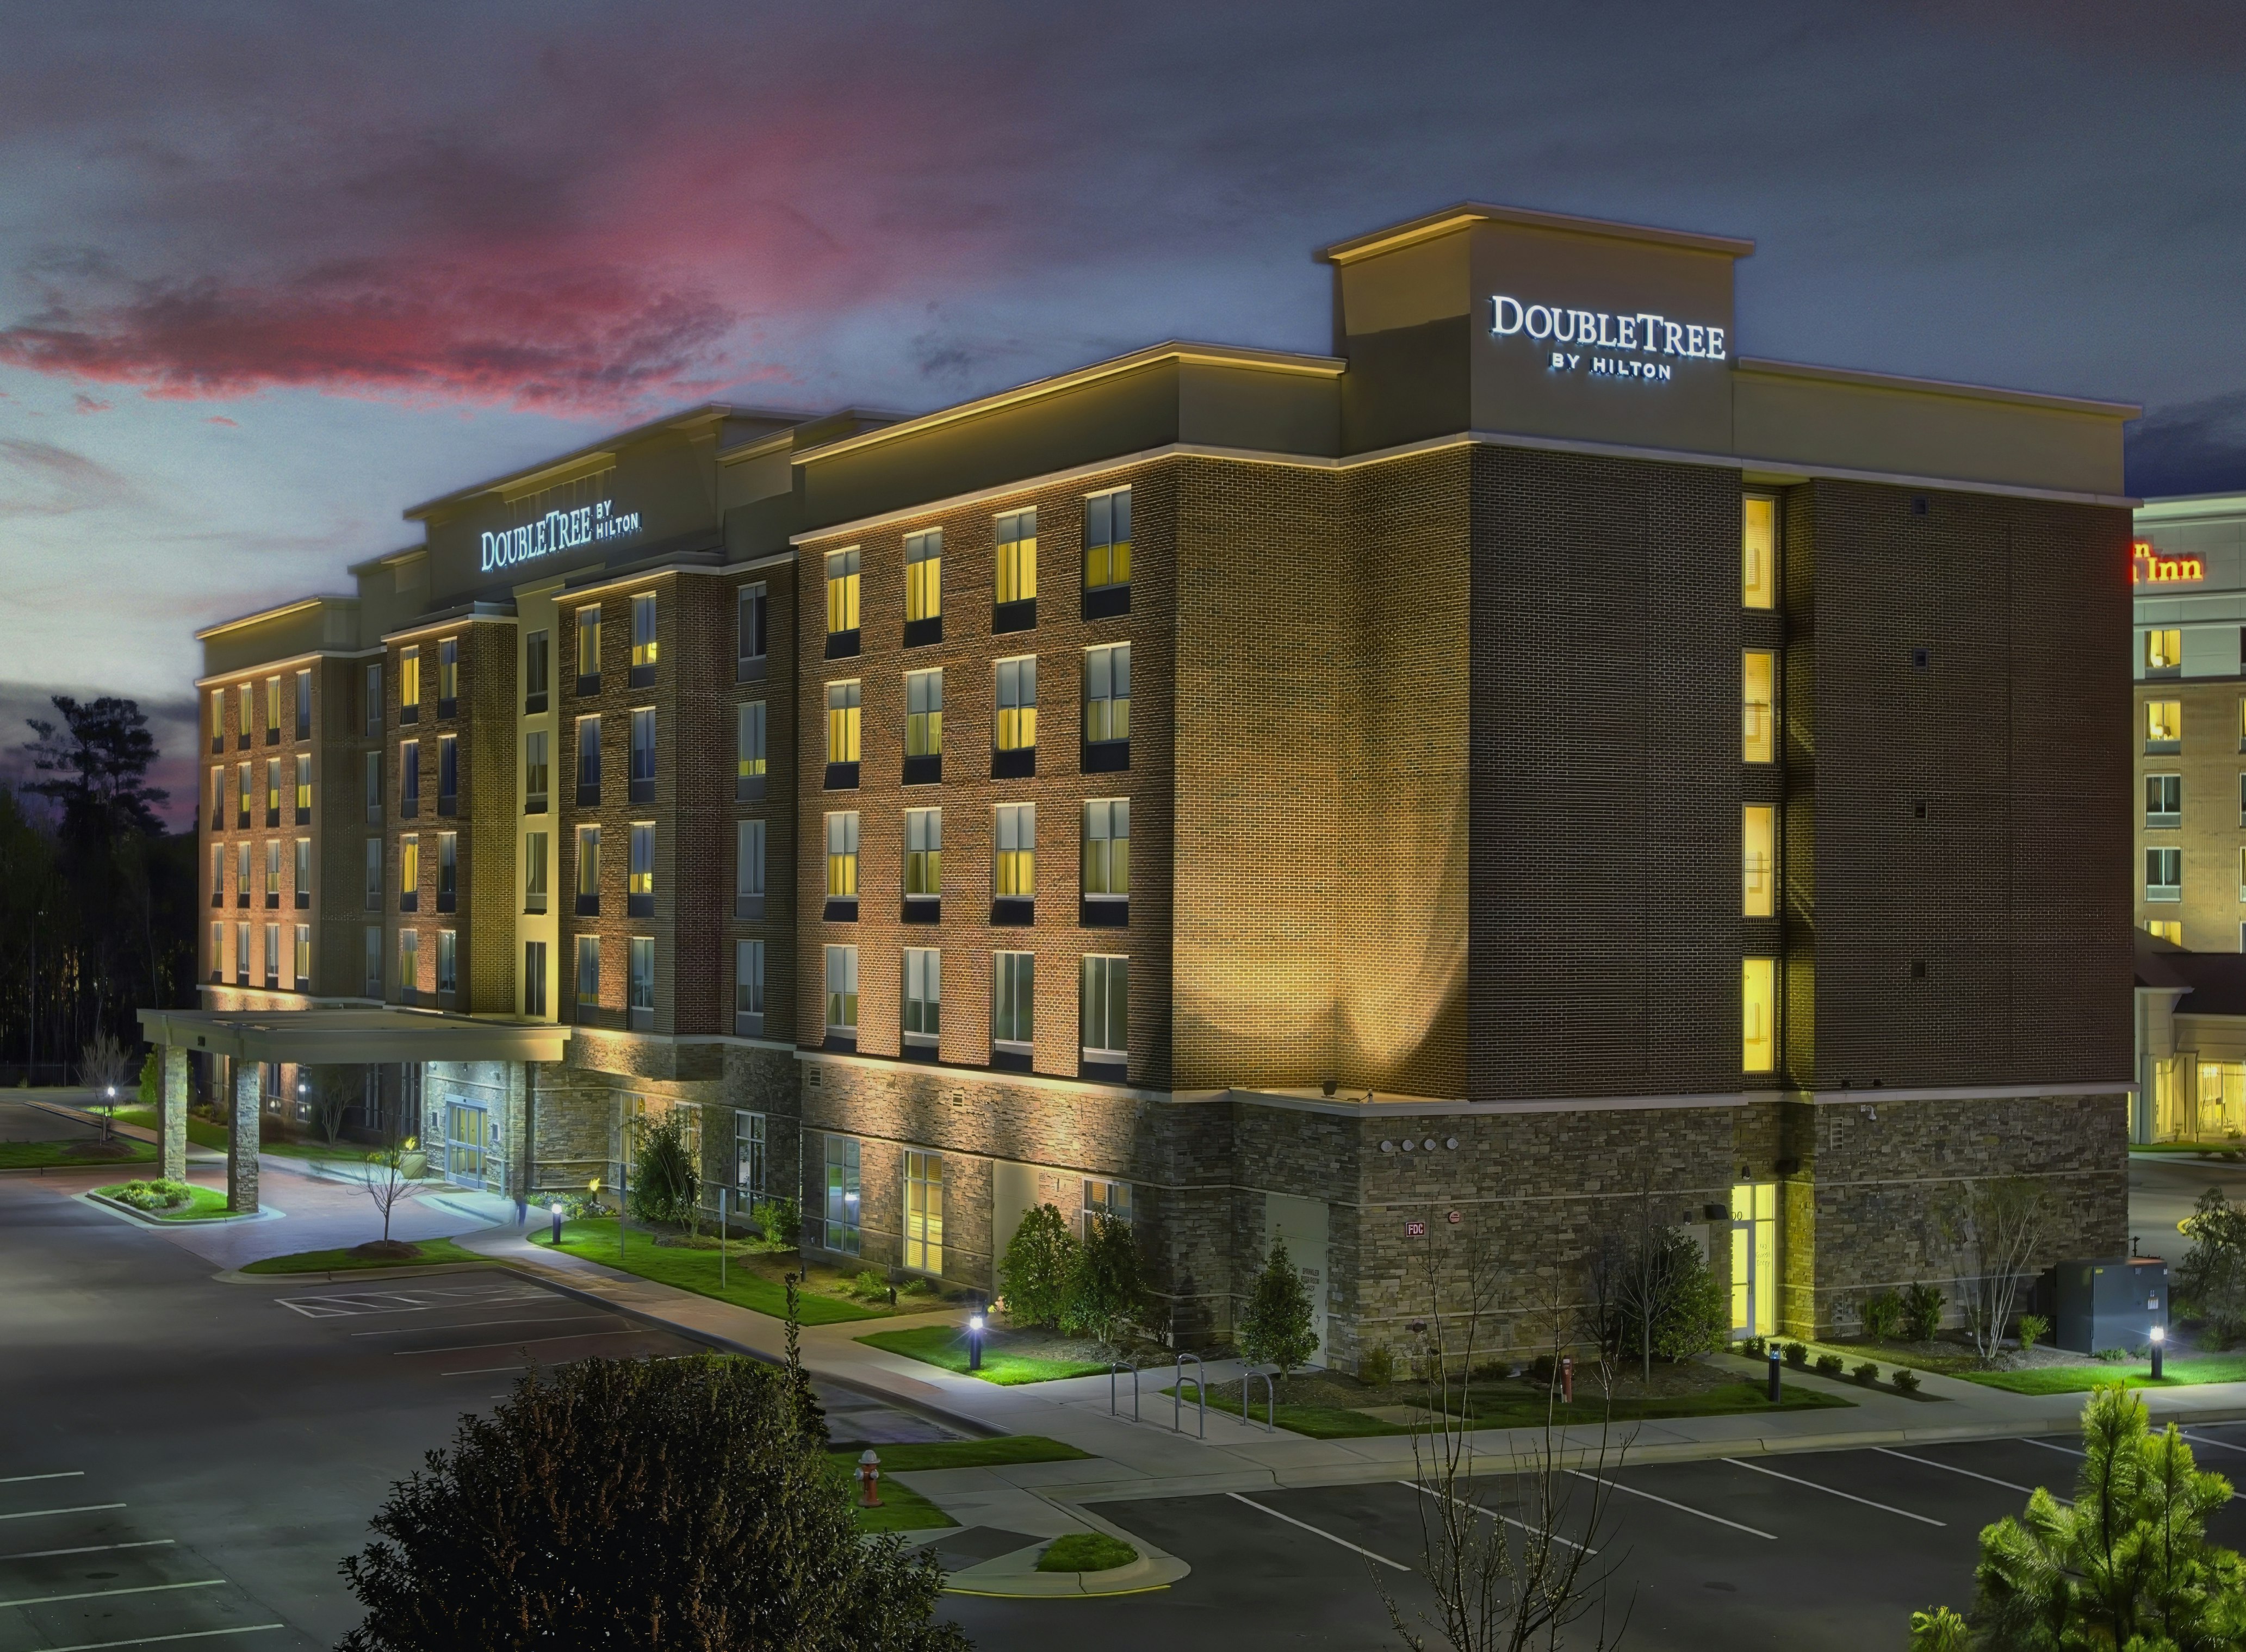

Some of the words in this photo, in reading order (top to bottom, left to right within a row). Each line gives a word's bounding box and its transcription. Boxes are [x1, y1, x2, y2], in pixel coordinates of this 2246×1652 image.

[1552, 352, 1580, 369] BY
[1593, 357, 1671, 380] HILTON
[597, 499, 612, 519] BY
[596, 512, 638, 539] HILTON
[2148, 557, 2202, 581] Inn
[1409, 1223, 1424, 1235] FDC
